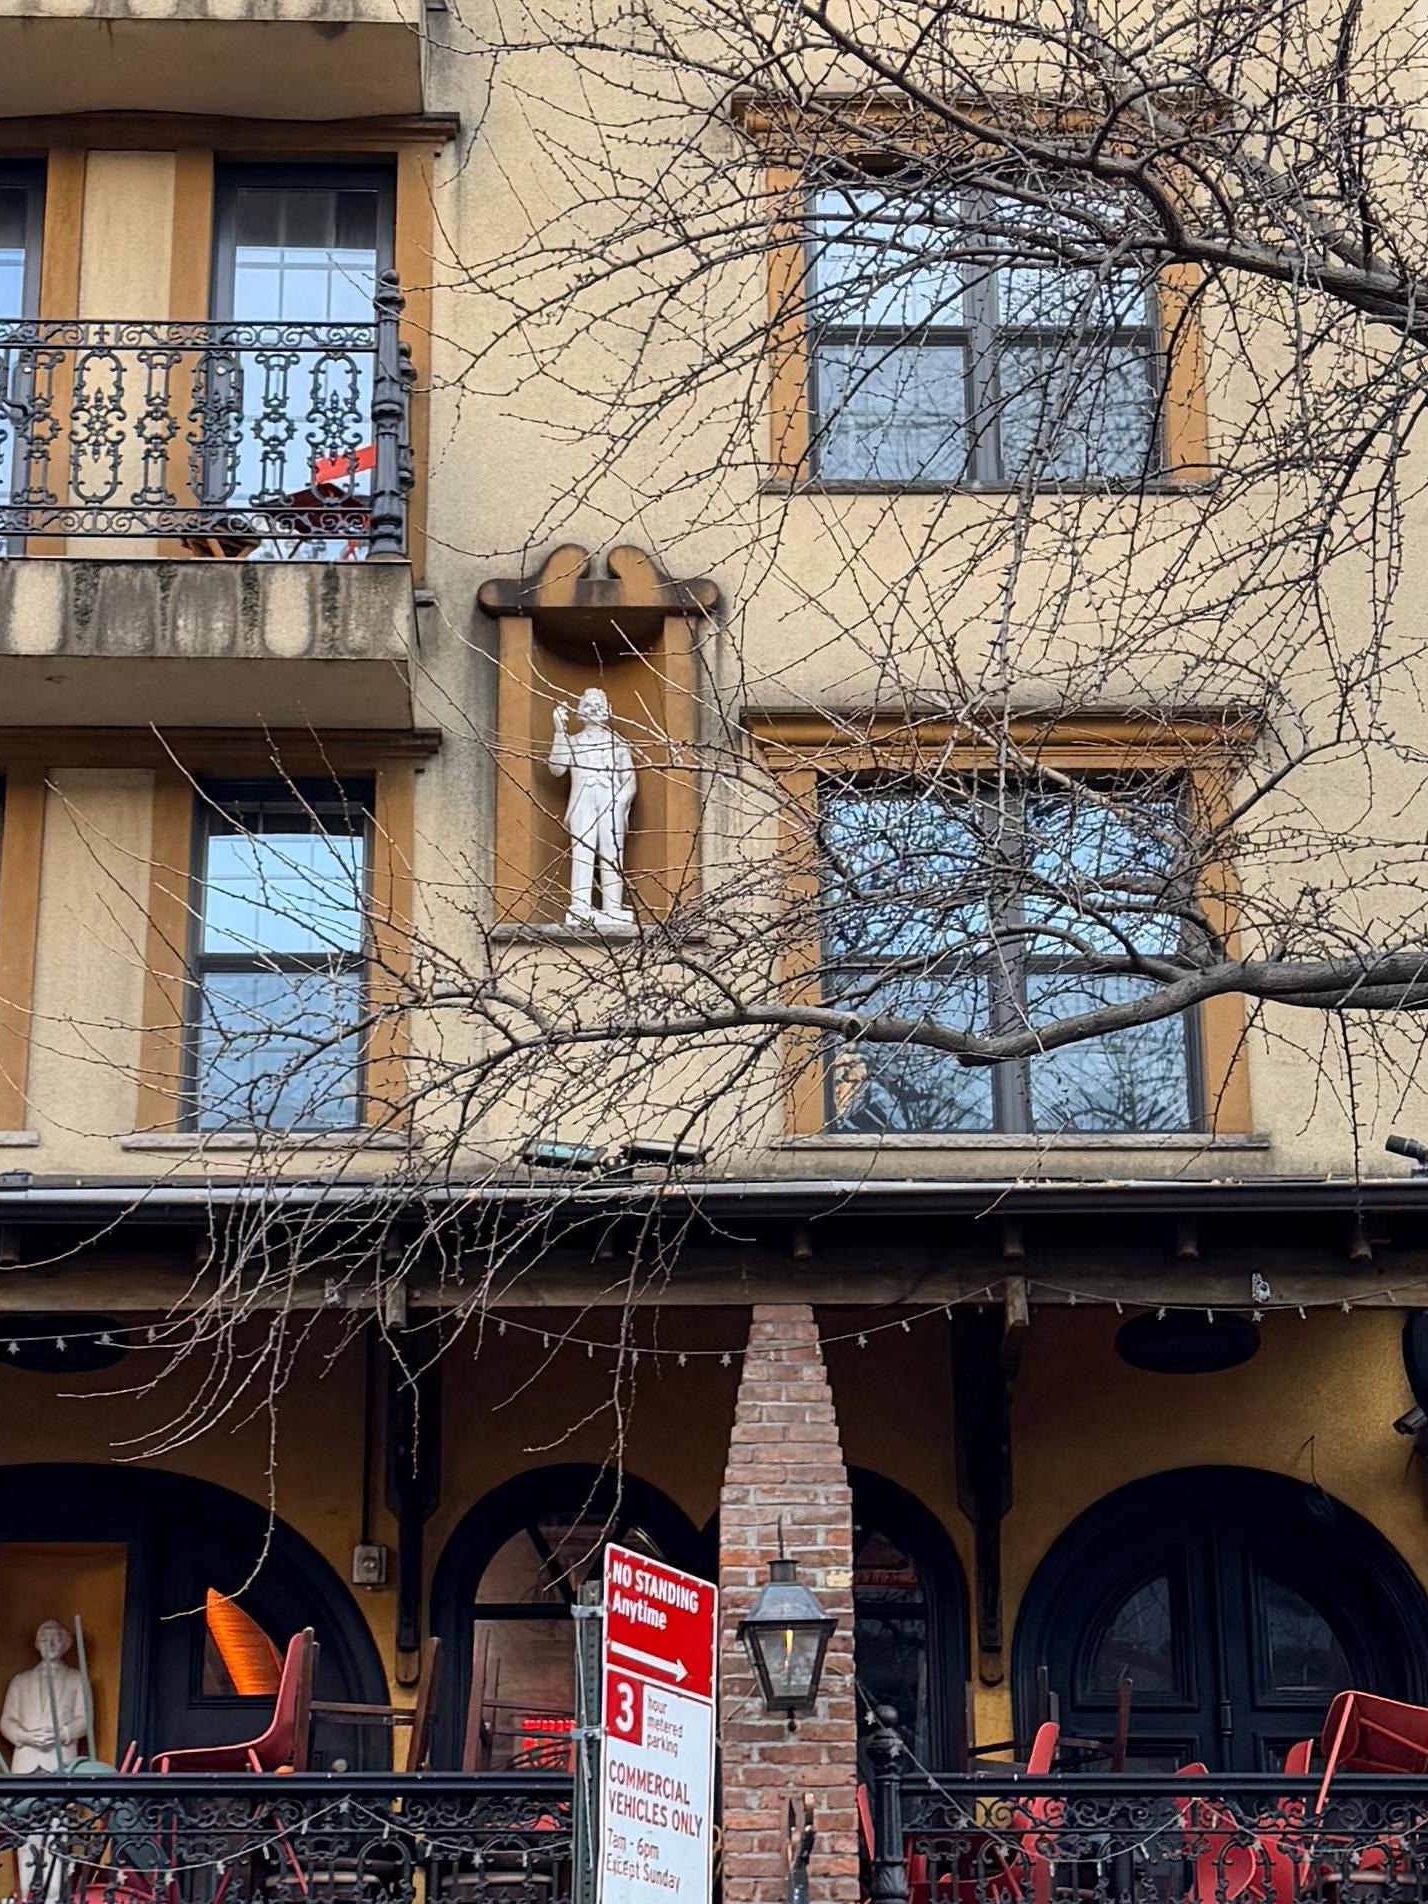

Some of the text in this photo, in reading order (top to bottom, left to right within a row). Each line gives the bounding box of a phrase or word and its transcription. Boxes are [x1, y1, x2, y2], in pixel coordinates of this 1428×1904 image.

[613, 1560, 699, 1614] NO STANDING
[612, 1590, 668, 1630] Anytime
[615, 1682, 634, 1732] 3
[647, 1695, 668, 1714] hour
[646, 1734, 679, 1758] parking
[647, 1716, 683, 1738] metered
[609, 1759, 690, 1805] COMMERCIAL
[609, 1788, 703, 1838] VEHICLES ONLY
[607, 1827, 627, 1853] 7am
[637, 1837, 660, 1860] 6pm
[606, 1853, 681, 1893] Except Sunday
